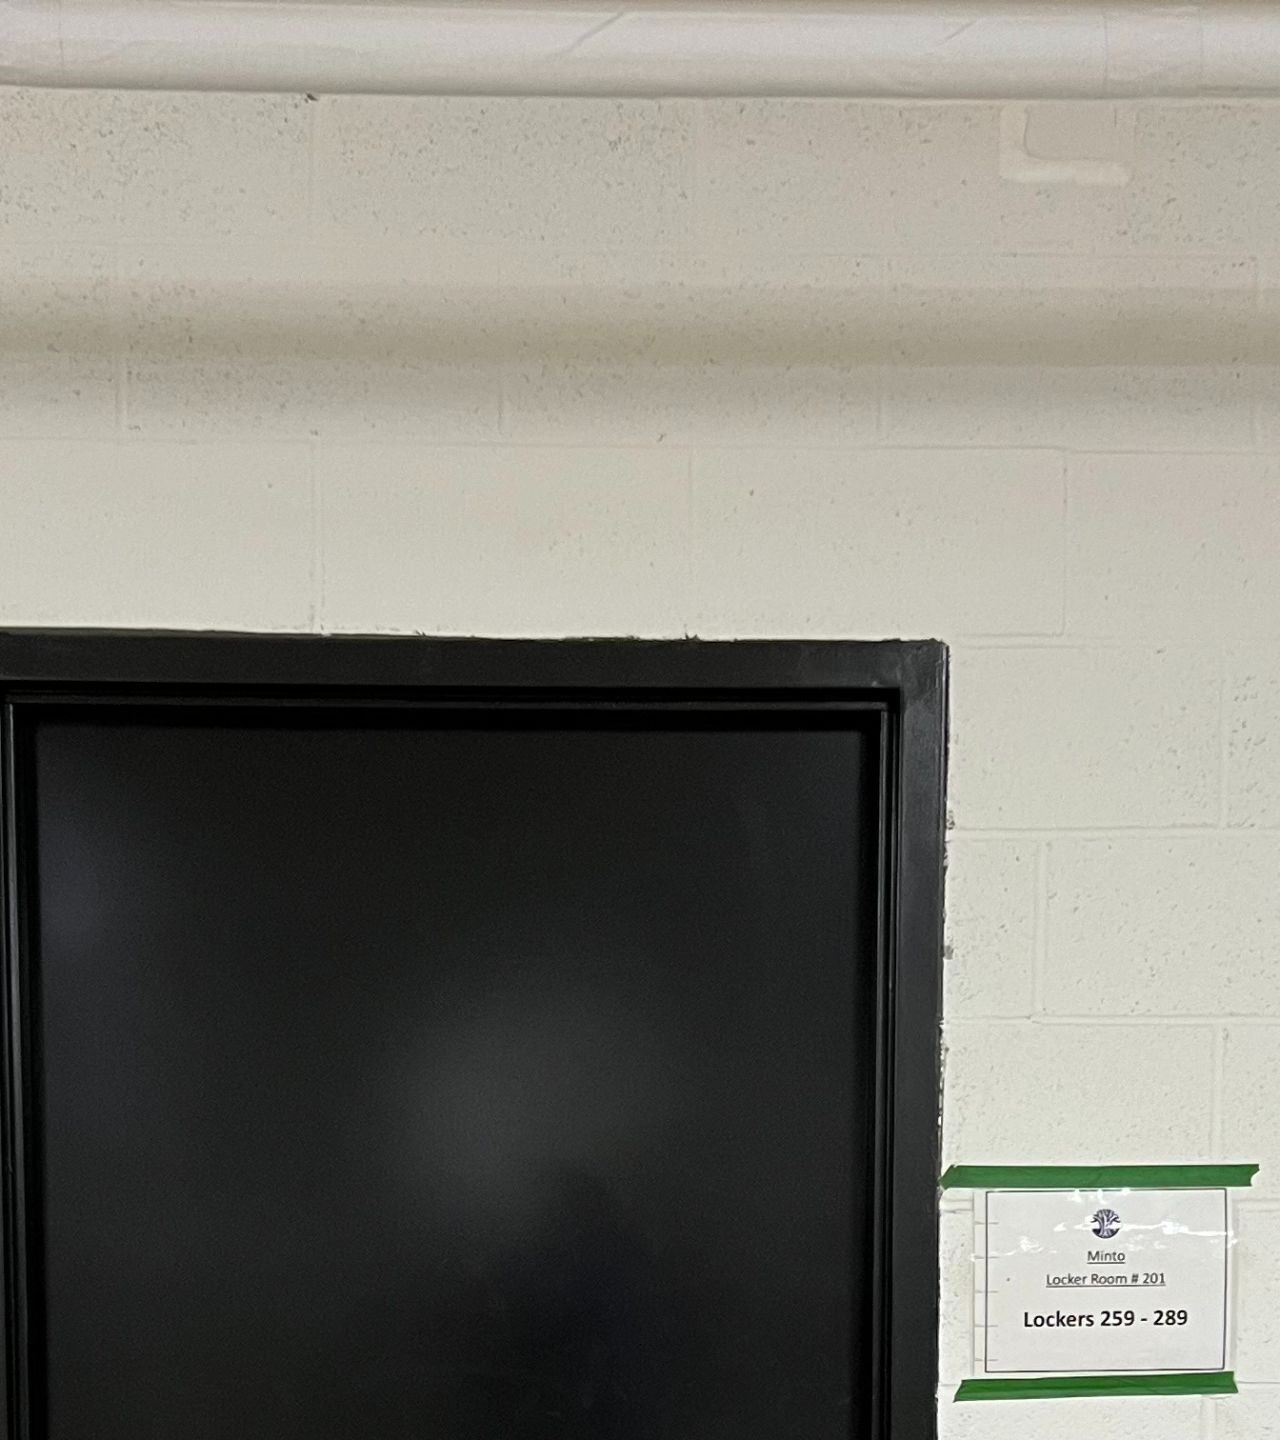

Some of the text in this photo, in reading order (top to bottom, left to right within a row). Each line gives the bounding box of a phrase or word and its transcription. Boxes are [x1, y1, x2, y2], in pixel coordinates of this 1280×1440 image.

[1087, 1250, 1126, 1262] Minto
[1046, 1272, 1165, 1285] Locker Room # 201
[1024, 1310, 1094, 1327] Lockers
[1100, 1310, 1135, 1326] 259
[1153, 1309, 1188, 1326] 289
